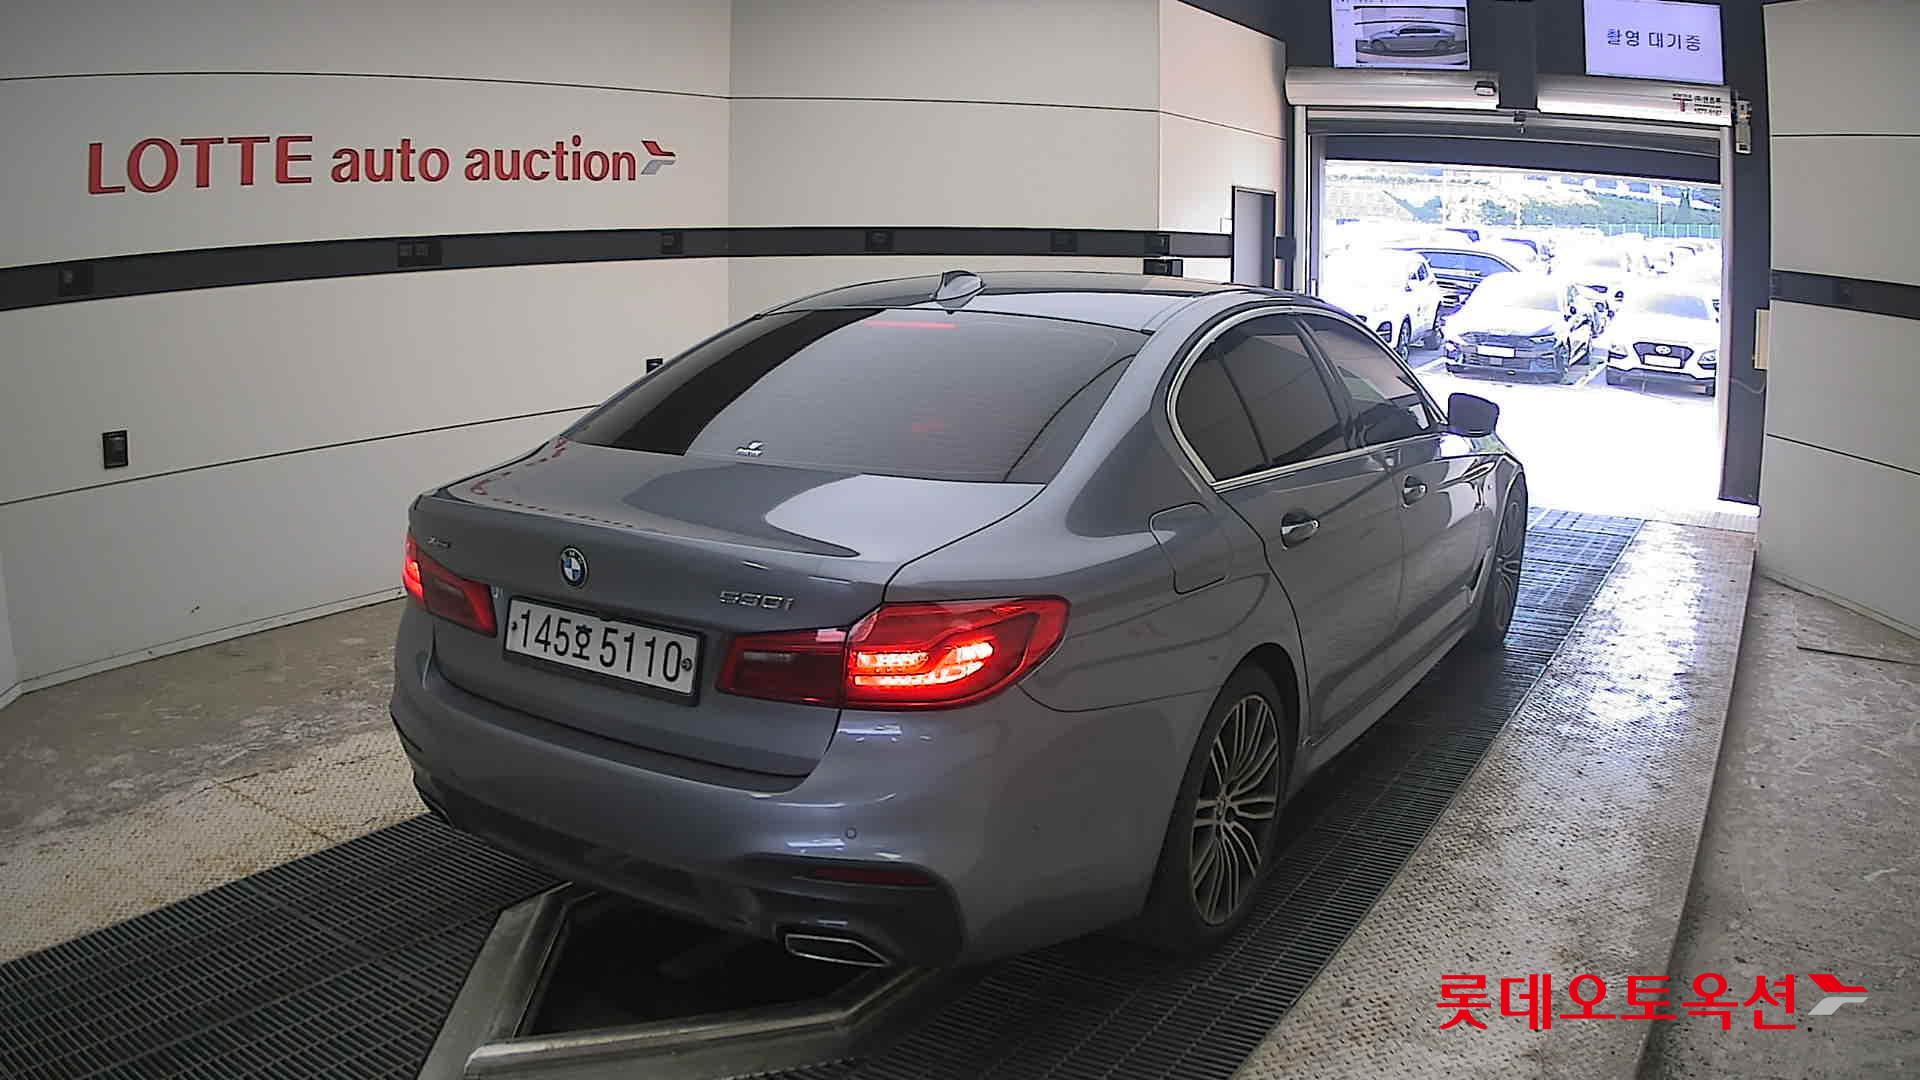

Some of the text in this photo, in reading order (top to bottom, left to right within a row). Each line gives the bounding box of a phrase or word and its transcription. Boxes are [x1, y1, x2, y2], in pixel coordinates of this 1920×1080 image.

[1648, 32, 1701, 52] 대기중
[88, 134, 637, 195] LOTTE auto auction
[520, 609, 683, 682] 145호 5110
